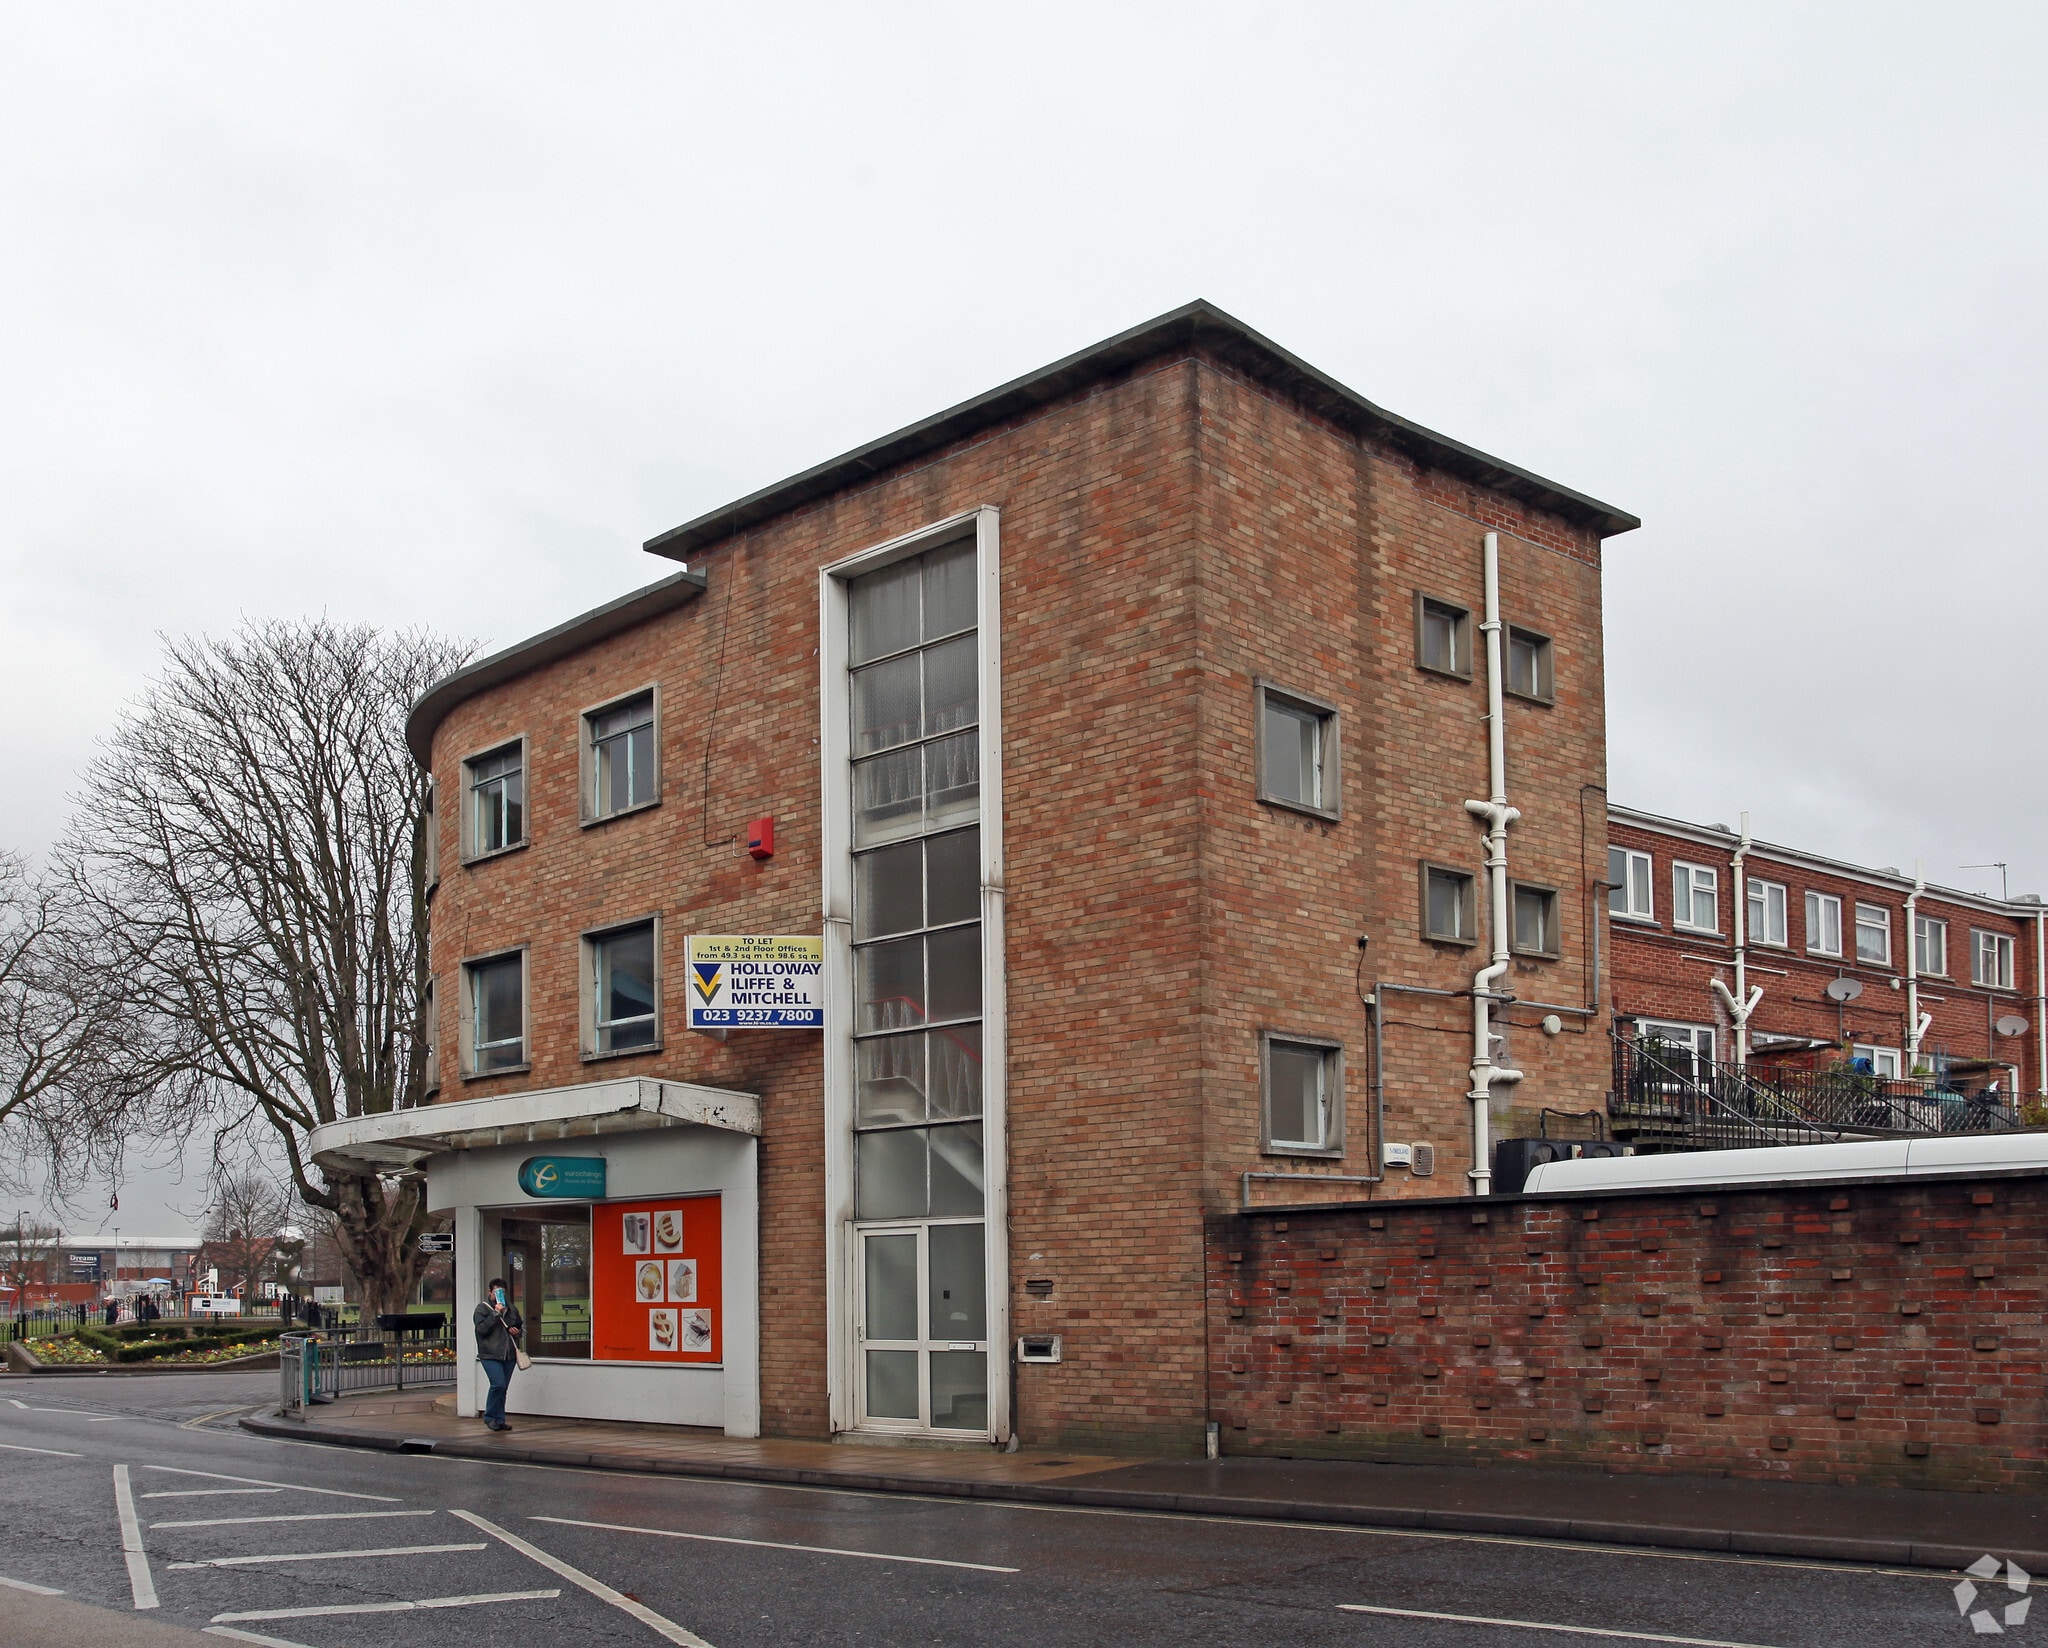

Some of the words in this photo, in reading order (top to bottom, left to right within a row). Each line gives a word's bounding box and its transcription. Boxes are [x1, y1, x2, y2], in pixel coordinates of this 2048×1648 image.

[731, 963, 822, 975] HOLLOWAY
[731, 978, 775, 990] ILIFFE
[783, 978, 795, 990] &
[731, 993, 811, 1004] MITCHELL
[703, 1010, 730, 1021] 023
[737, 1010, 772, 1021] 9237
[777, 1010, 814, 1021] 7800
